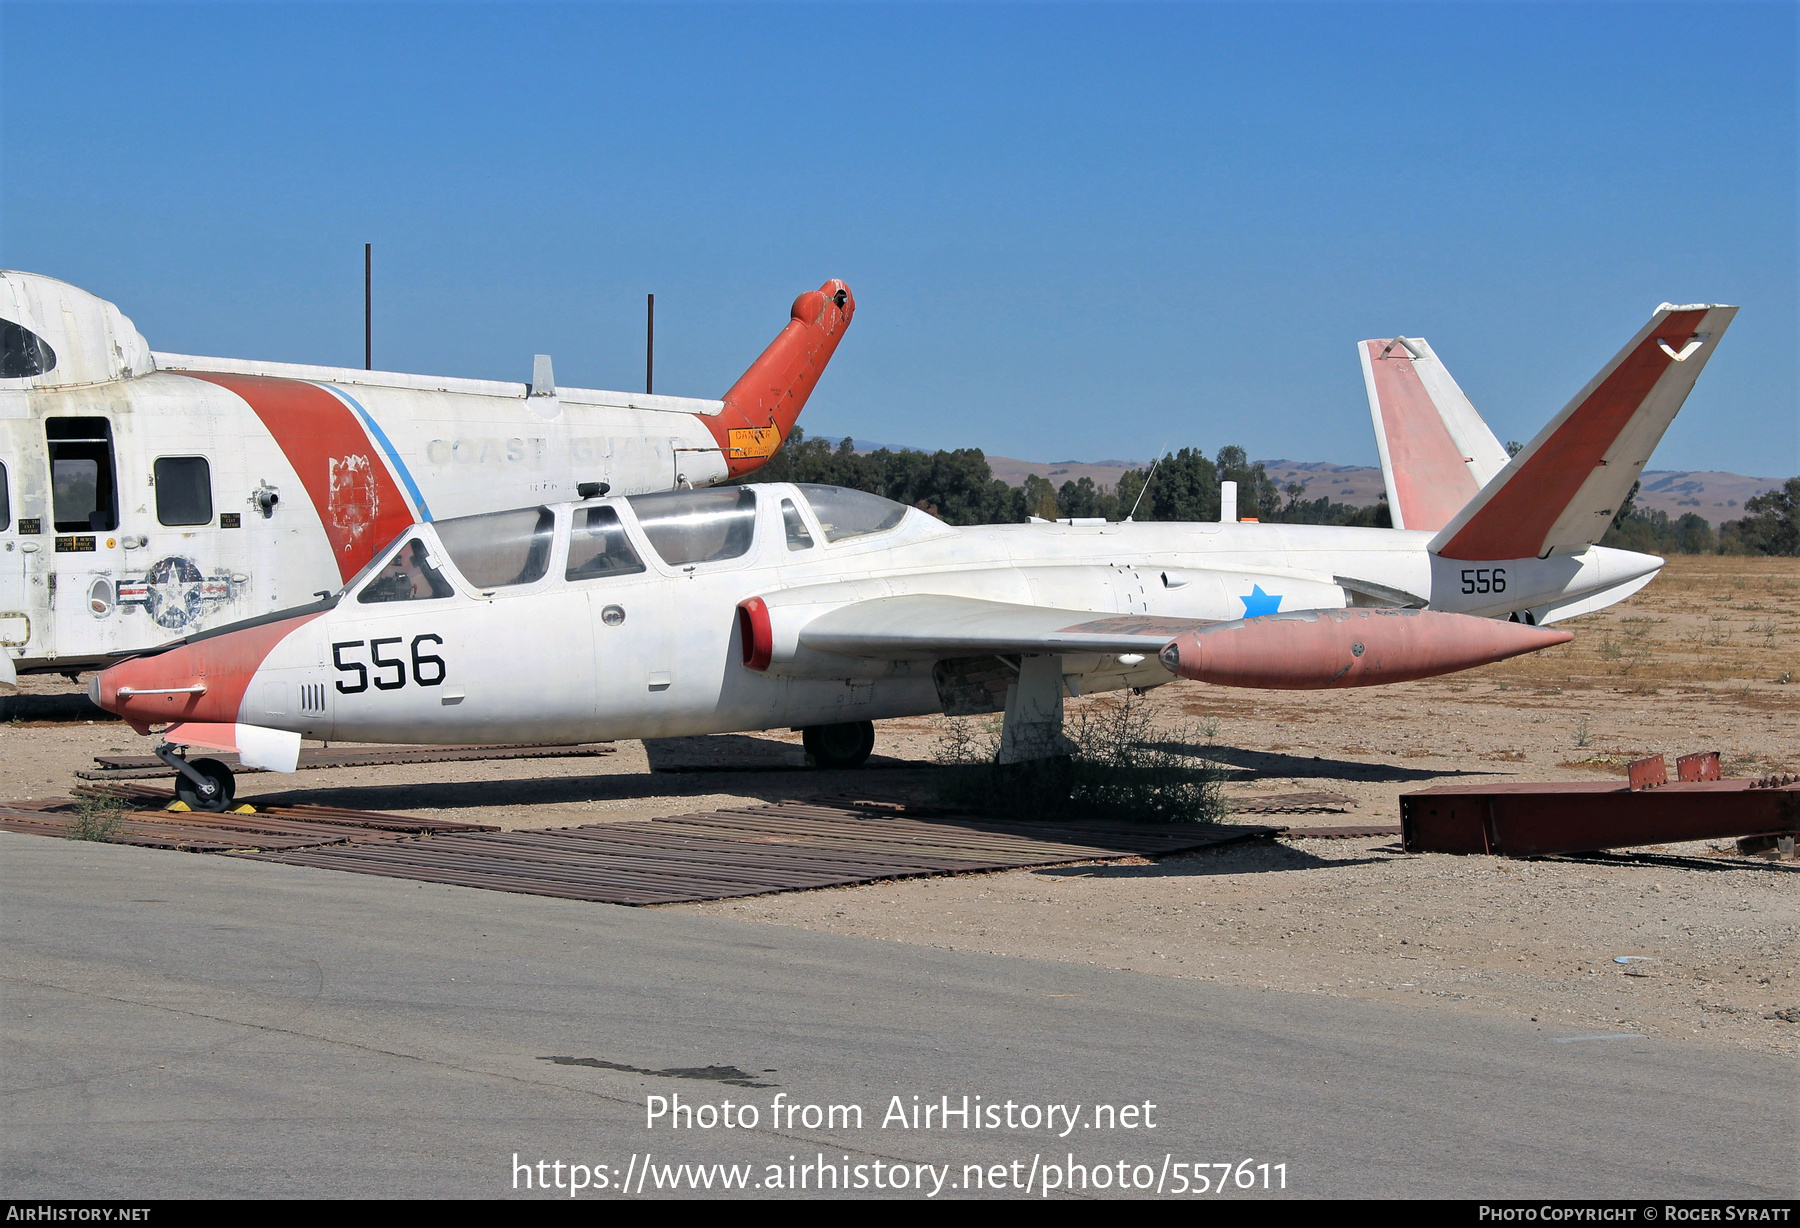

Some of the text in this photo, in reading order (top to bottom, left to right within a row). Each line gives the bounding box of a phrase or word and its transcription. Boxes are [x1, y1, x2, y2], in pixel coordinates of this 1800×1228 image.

[735, 429, 771, 441] DANGER
[426, 436, 547, 465] COAST
[1461, 568, 1507, 595] 556
[332, 633, 446, 695] 556
